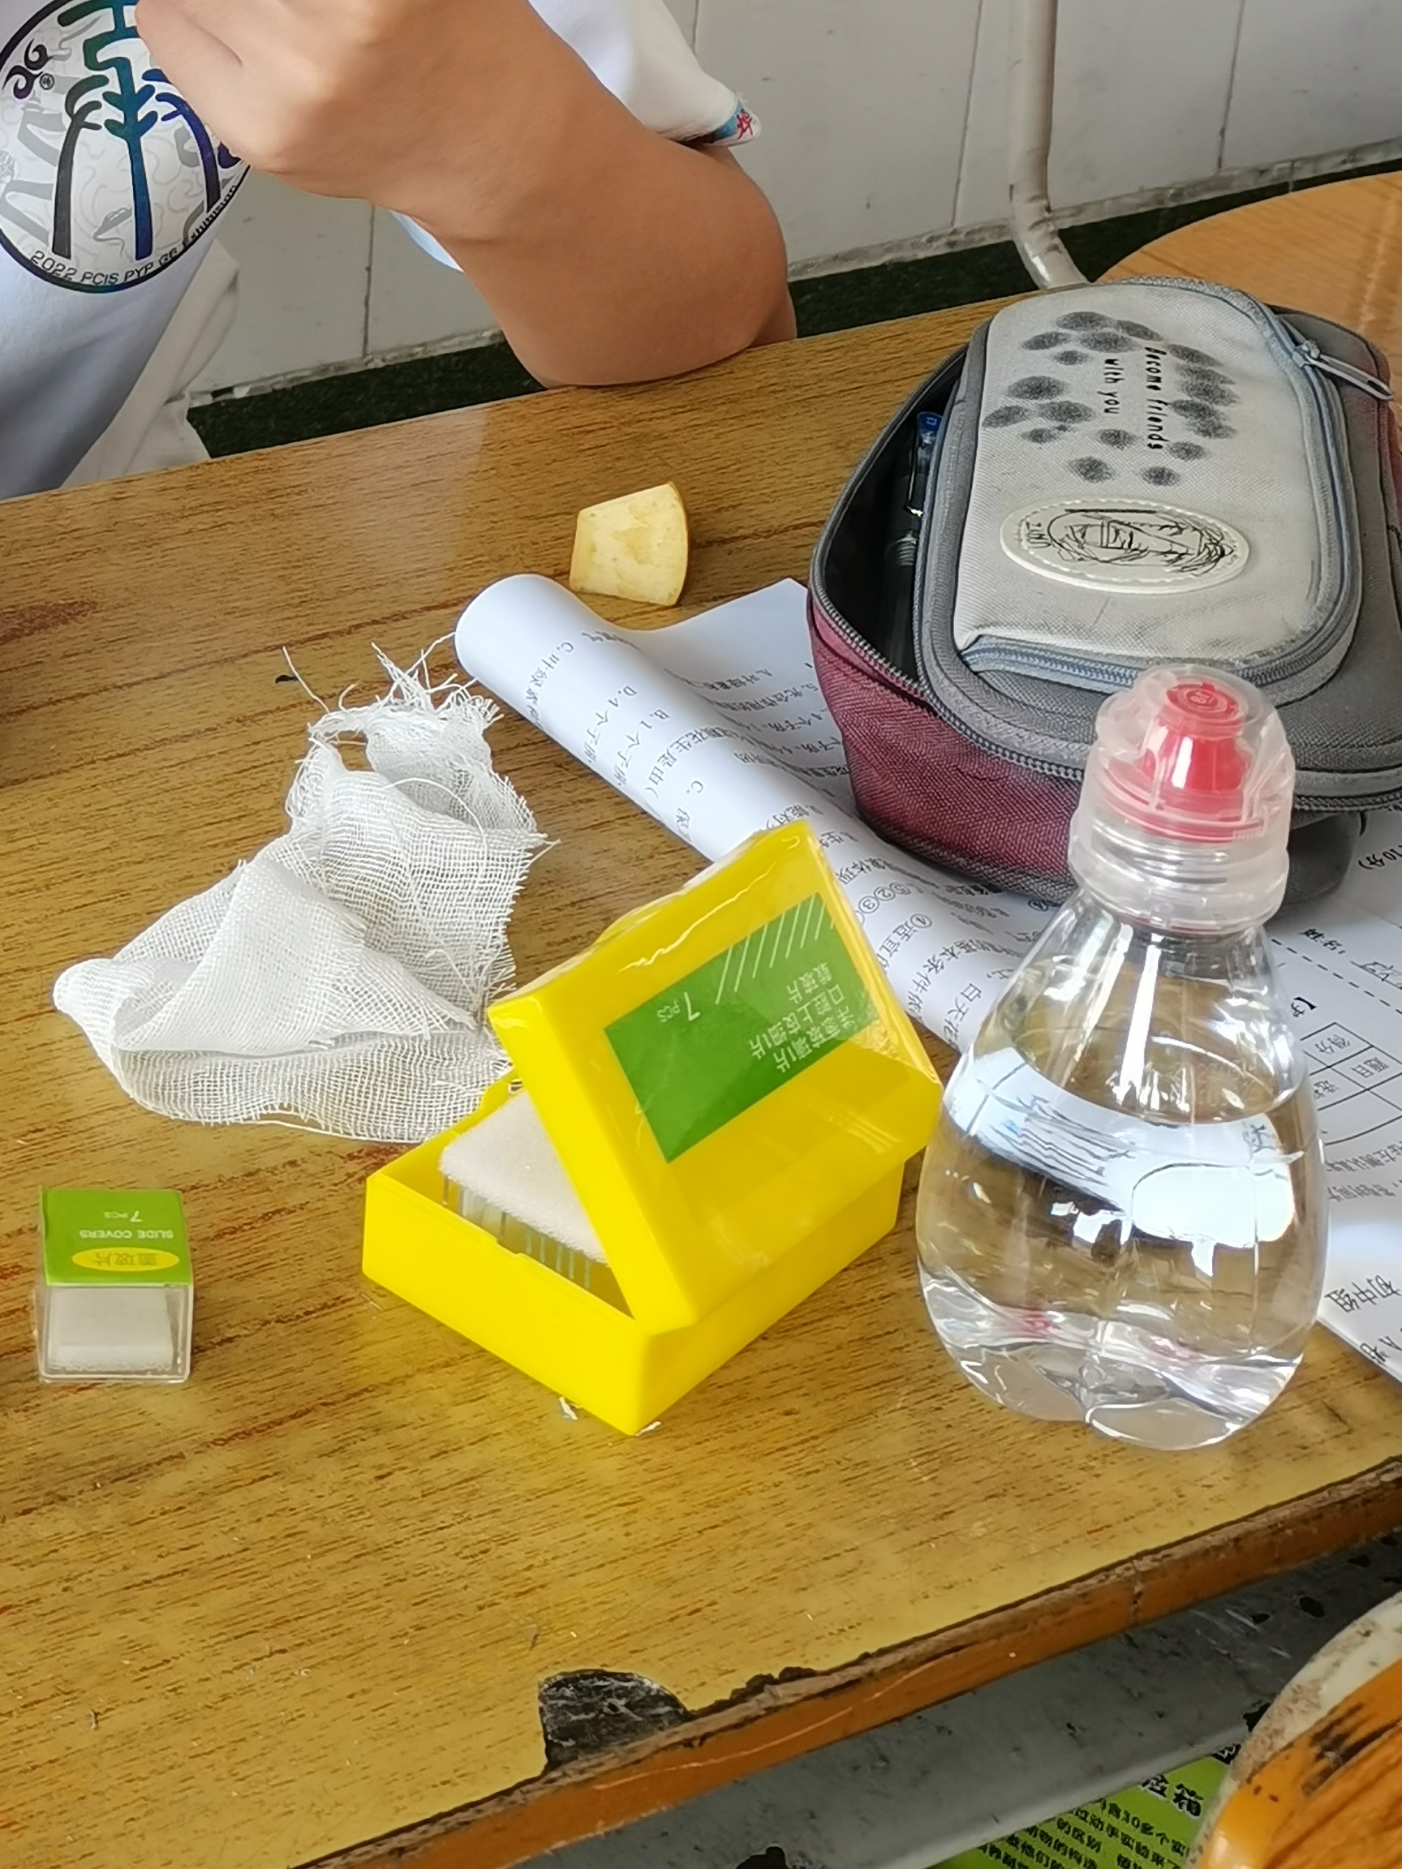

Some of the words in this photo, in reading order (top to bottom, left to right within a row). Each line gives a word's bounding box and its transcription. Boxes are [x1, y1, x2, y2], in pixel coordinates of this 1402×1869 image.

[30, 250, 77, 281] 2022
[80, 271, 120, 285] PCIS
[123, 261, 154, 281] PYP
[1104, 358, 1125, 384] with
[1097, 390, 1120, 415] you
[1314, 1034, 1351, 1058] 得分
[1351, 1055, 1389, 1080] 题目
[79, 1229, 133, 1239] COVERS
[137, 1229, 174, 1239] SLIDE
[1324, 1275, 1402, 1313] 初中组
